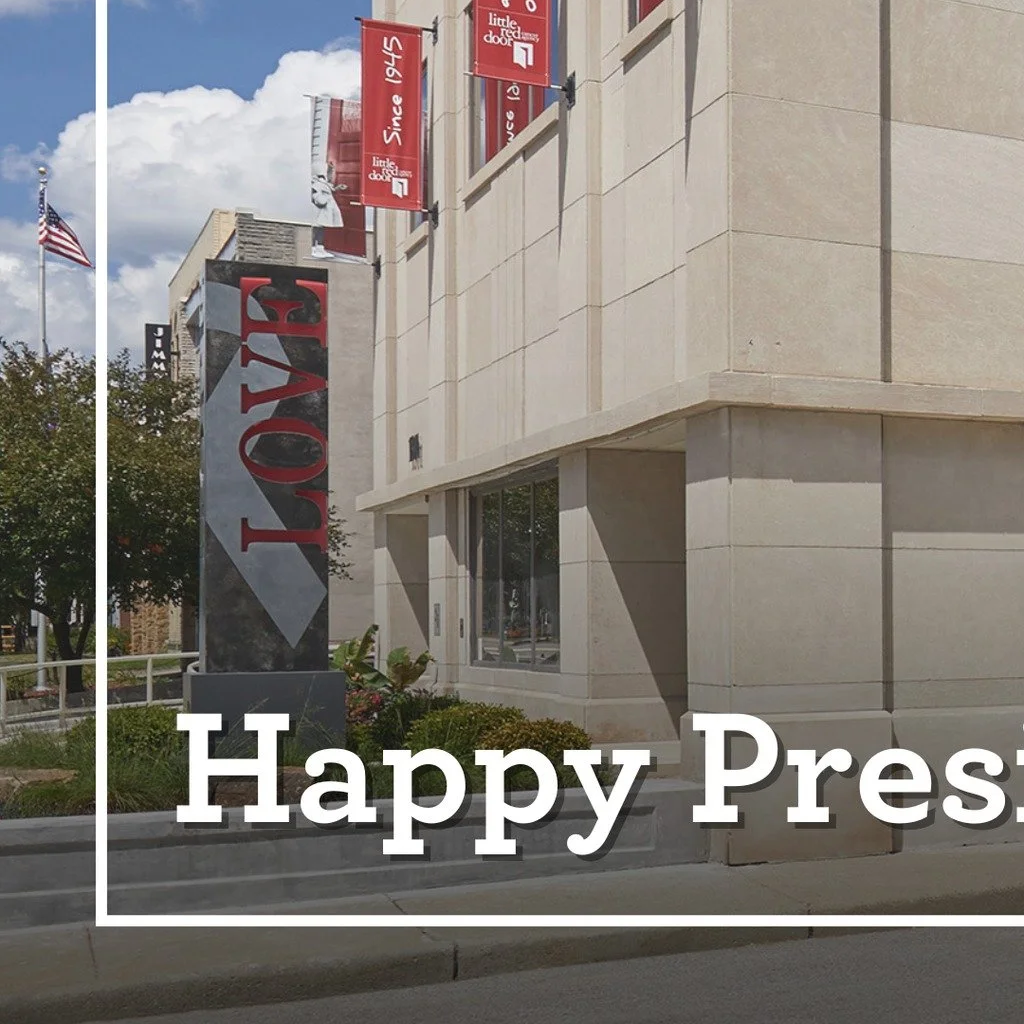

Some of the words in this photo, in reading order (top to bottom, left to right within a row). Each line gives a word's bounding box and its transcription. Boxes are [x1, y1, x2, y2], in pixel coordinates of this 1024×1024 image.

[483, 29, 514, 47] door
[488, 12, 518, 30] little
[381, 36, 404, 84] 1945
[383, 94, 403, 146] Since
[238, 276, 329, 554] LOVE
